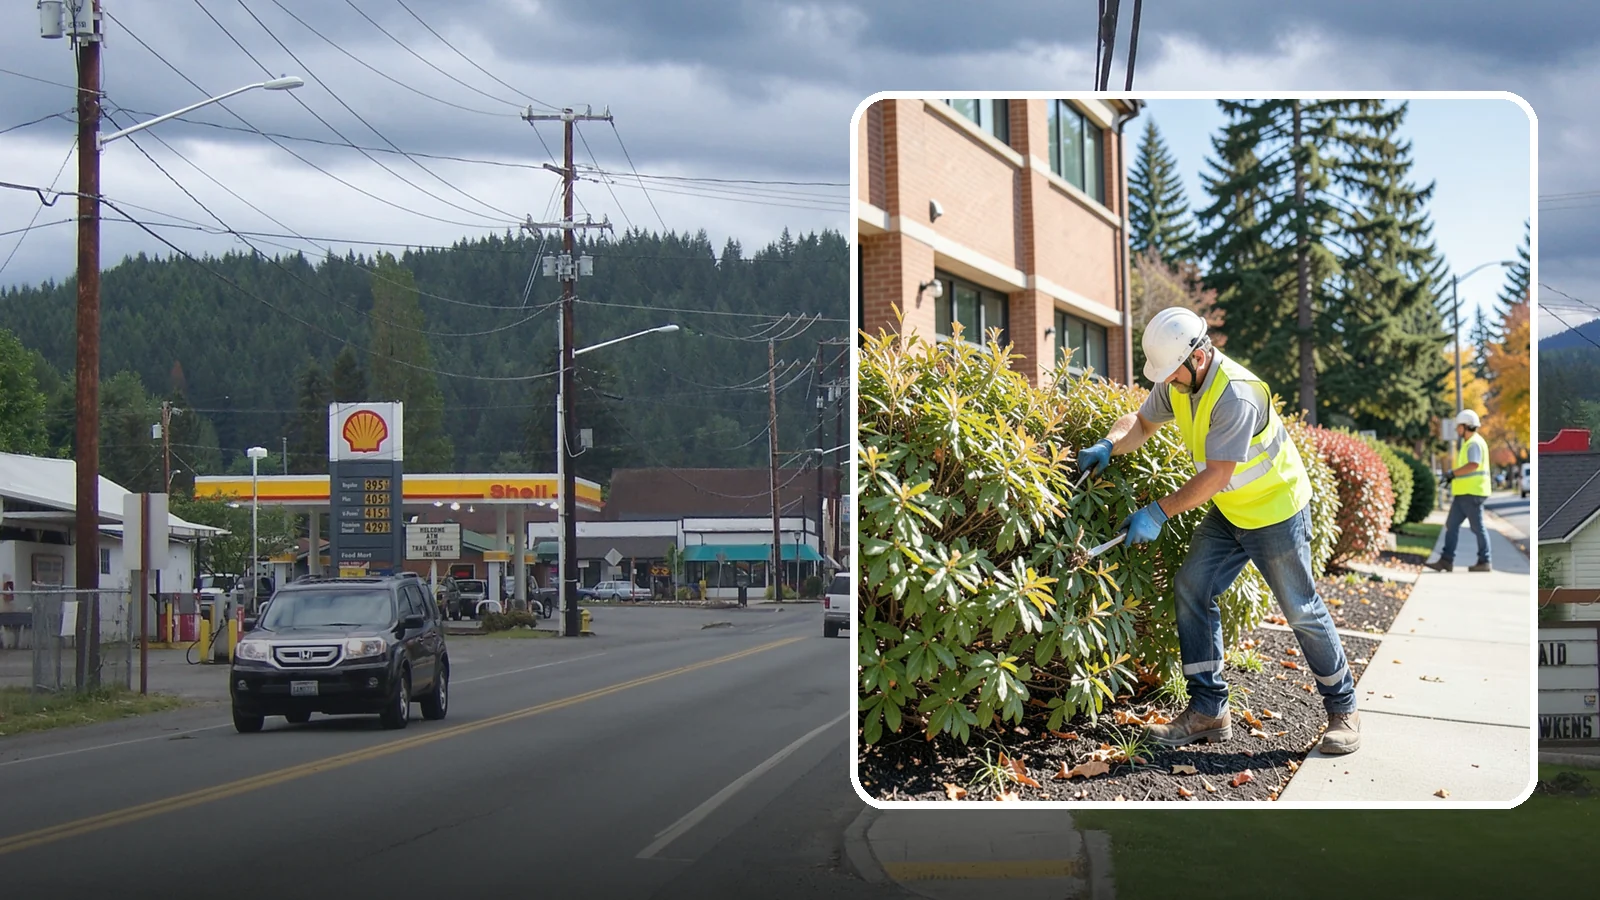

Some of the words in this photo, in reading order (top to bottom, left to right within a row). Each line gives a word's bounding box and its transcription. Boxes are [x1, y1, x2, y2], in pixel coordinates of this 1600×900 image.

[366, 480, 383, 490] 395
[490, 484, 547, 499] Shell
[366, 494, 383, 504] 405
[366, 508, 383, 518] 415
[366, 522, 383, 533] 429
